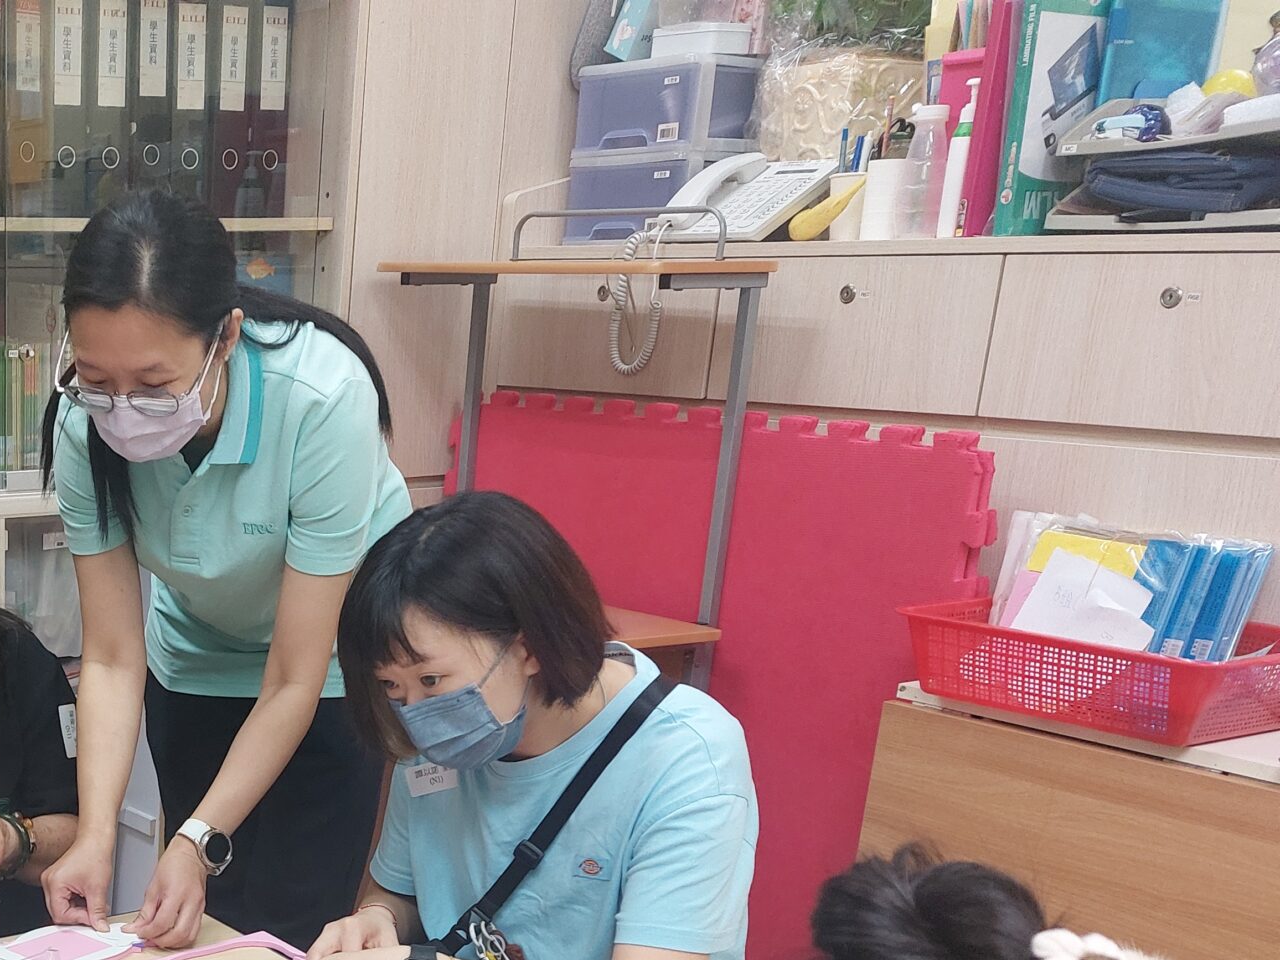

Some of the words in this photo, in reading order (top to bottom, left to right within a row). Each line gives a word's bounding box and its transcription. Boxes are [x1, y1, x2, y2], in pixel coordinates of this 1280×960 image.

[62, 26, 72, 72] 學生資料
[108, 29, 117, 75] 學生資料
[149, 20, 158, 65] 學生資料
[186, 33, 196, 79] 學生資料
[230, 36, 239, 79] 學生資料
[429, 775, 444, 786] (N1)
